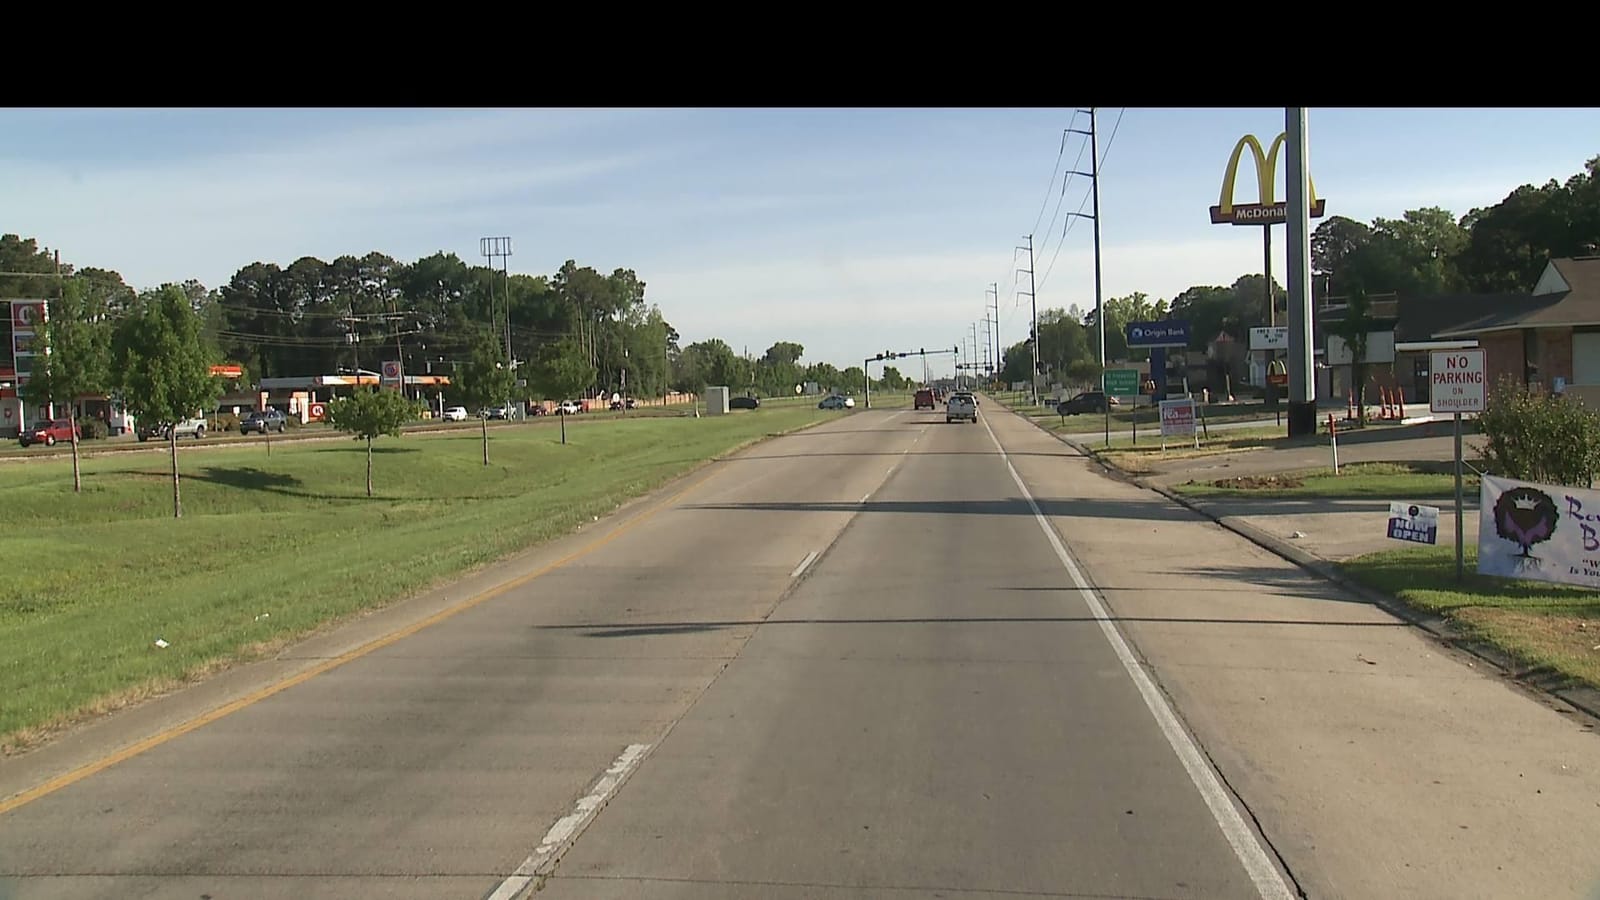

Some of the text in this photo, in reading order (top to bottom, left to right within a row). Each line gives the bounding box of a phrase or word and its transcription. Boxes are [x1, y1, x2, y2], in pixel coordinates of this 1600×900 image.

[1236, 207, 1287, 220] McDonal
[1144, 327, 1185, 338] Origin Bank
[1446, 356, 1469, 369] NO
[1433, 372, 1482, 385] PARKING
[1452, 387, 1464, 395] ON
[1437, 398, 1479, 408] SHOULDER
[1395, 519, 1428, 532] NOW
[1392, 529, 1429, 542] OPEN
[1579, 523, 1600, 551] B
[1582, 559, 1600, 569] "W
[1569, 566, 1600, 577] Is You
